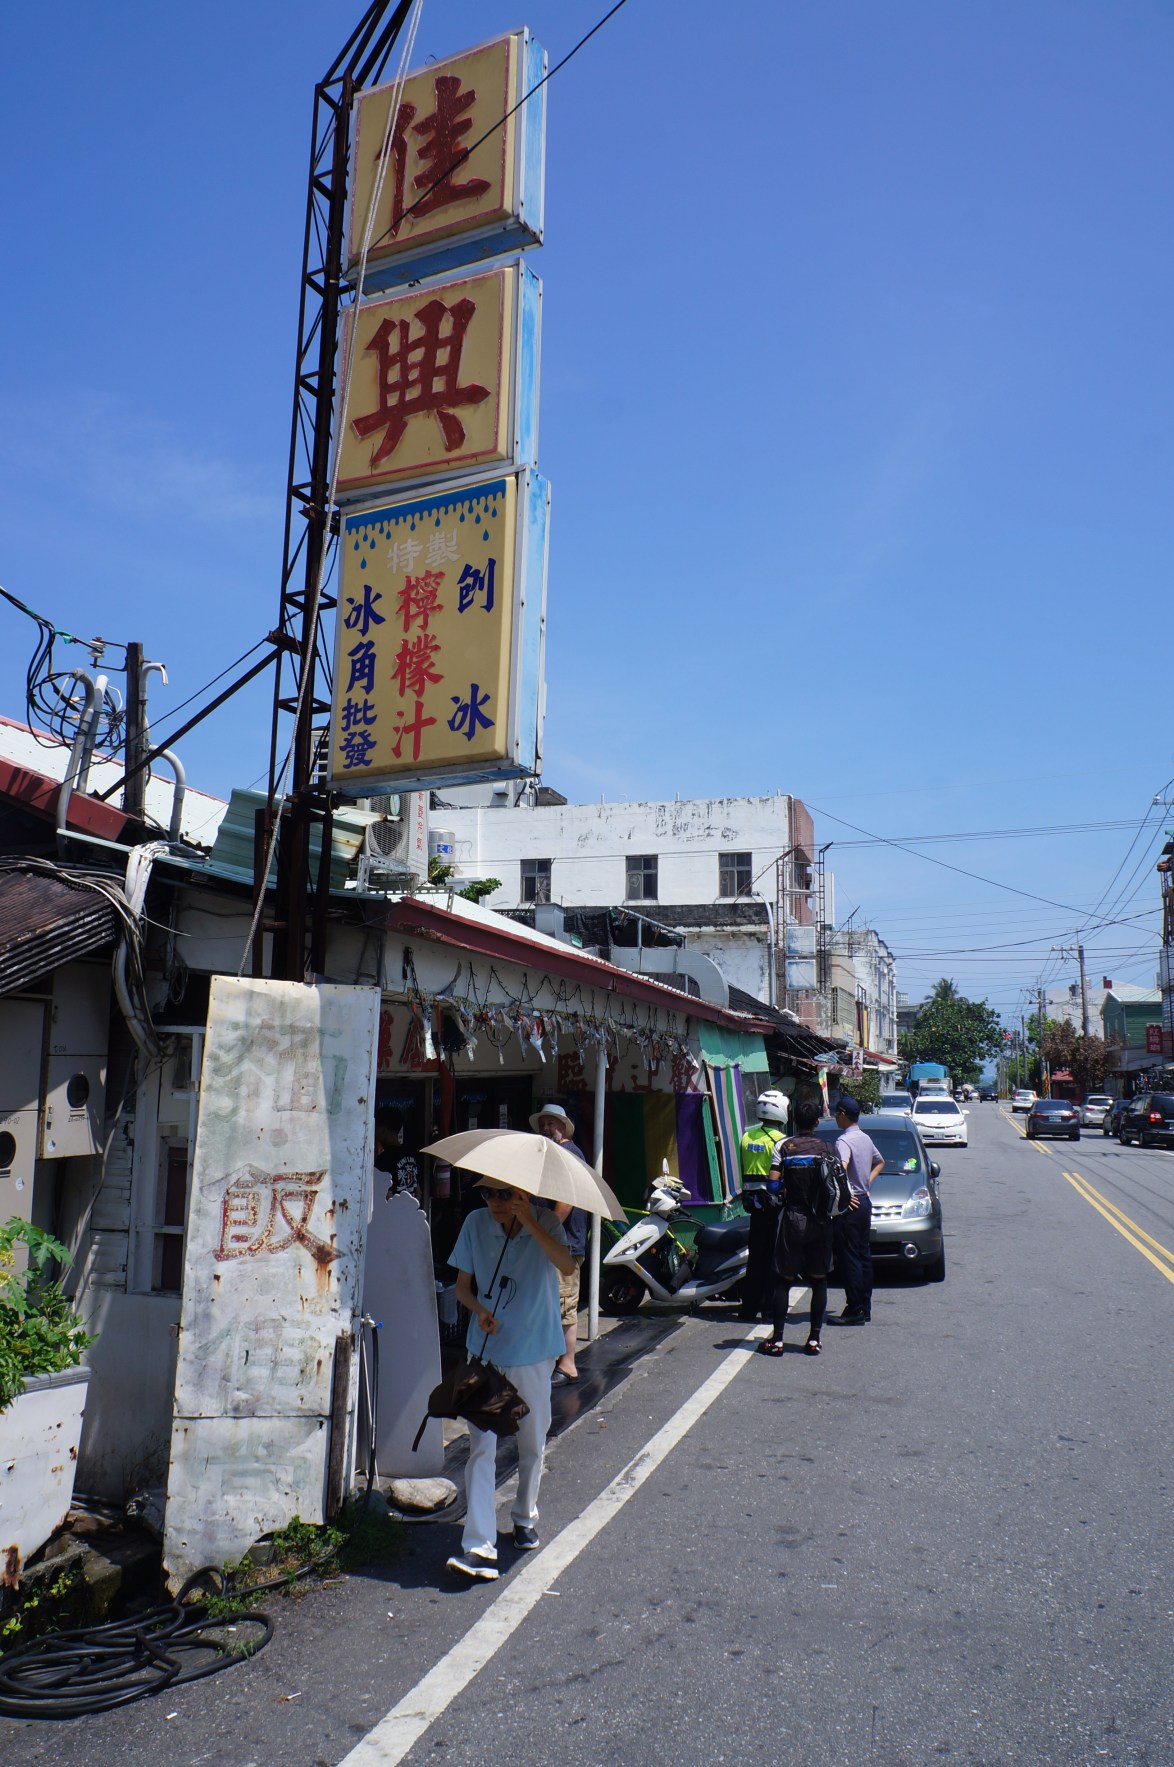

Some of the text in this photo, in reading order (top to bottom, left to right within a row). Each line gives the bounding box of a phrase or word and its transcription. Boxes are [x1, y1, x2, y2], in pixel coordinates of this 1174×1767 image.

[386, 527, 462, 574] 特製
[338, 584, 387, 770] 冰角批發
[390, 569, 446, 762] 檸檬汁
